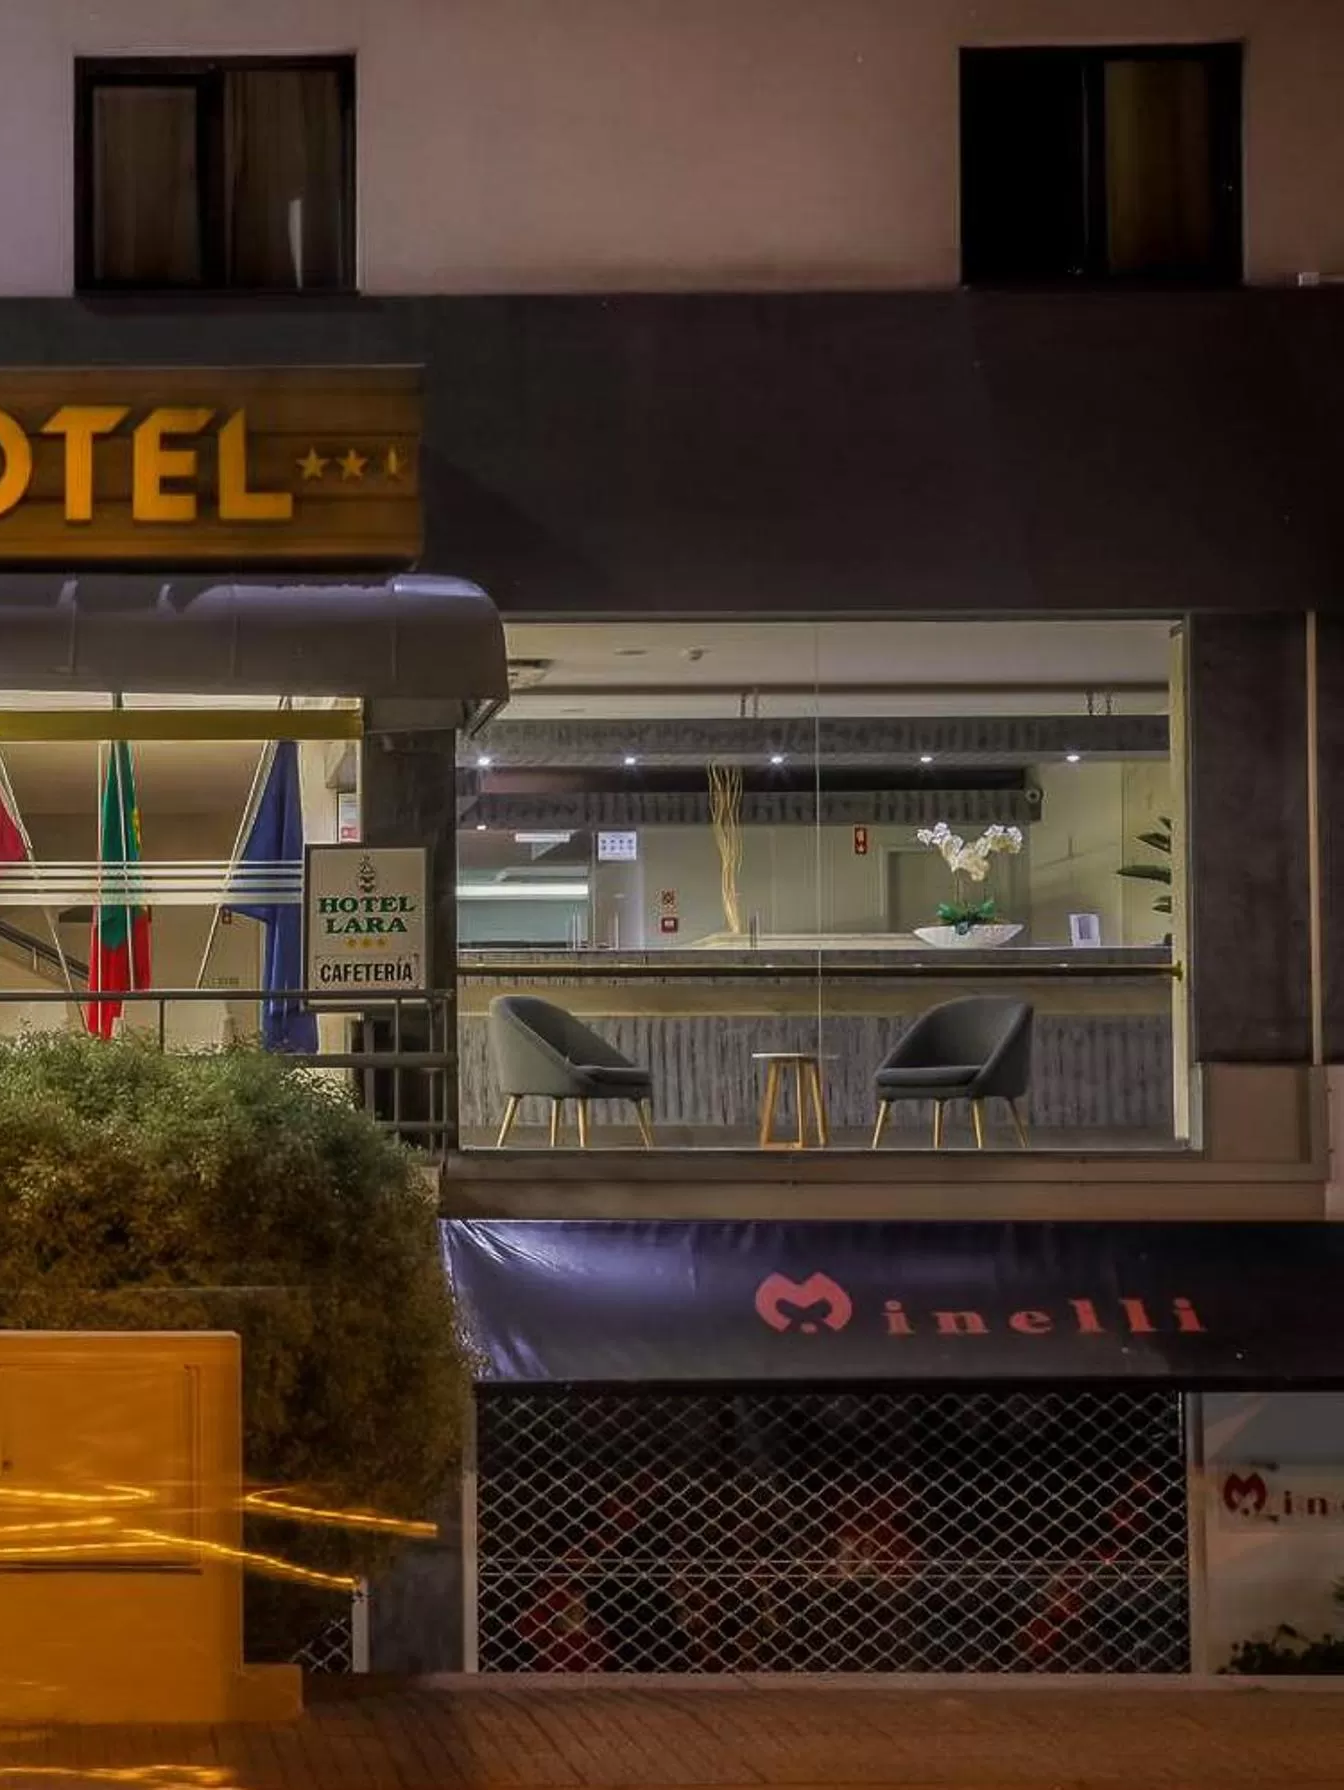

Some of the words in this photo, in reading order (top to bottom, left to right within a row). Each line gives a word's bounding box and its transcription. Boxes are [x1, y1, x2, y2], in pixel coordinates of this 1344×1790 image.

[319, 896, 416, 913] HOTEL
[326, 916, 408, 934] LARA
[320, 957, 413, 983] CAFETERÍA
[1223, 1472, 1344, 1516] Min
